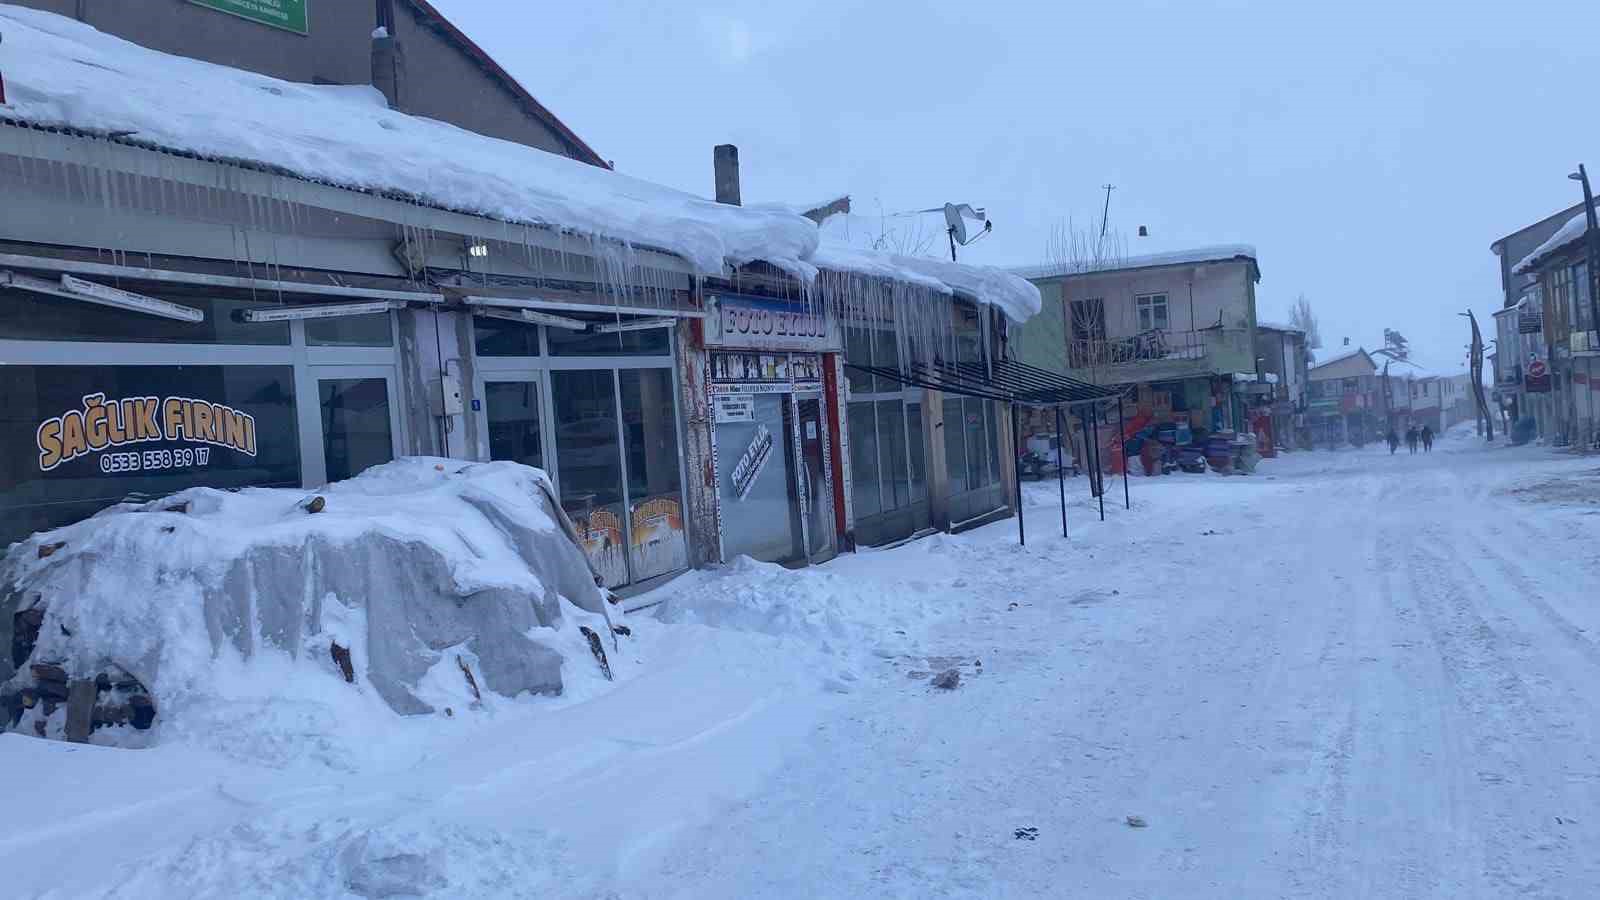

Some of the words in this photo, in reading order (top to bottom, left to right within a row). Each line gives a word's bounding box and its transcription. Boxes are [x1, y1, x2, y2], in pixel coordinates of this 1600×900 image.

[723, 307, 773, 335] FOTO
[37, 392, 161, 471] SAĞLIK
[162, 396, 257, 457] FIRINI
[100, 452, 140, 473] 0533
[143, 450, 173, 472] 558
[174, 448, 193, 468] 39
[195, 447, 210, 466] 17
[731, 453, 750, 487] FOTO
